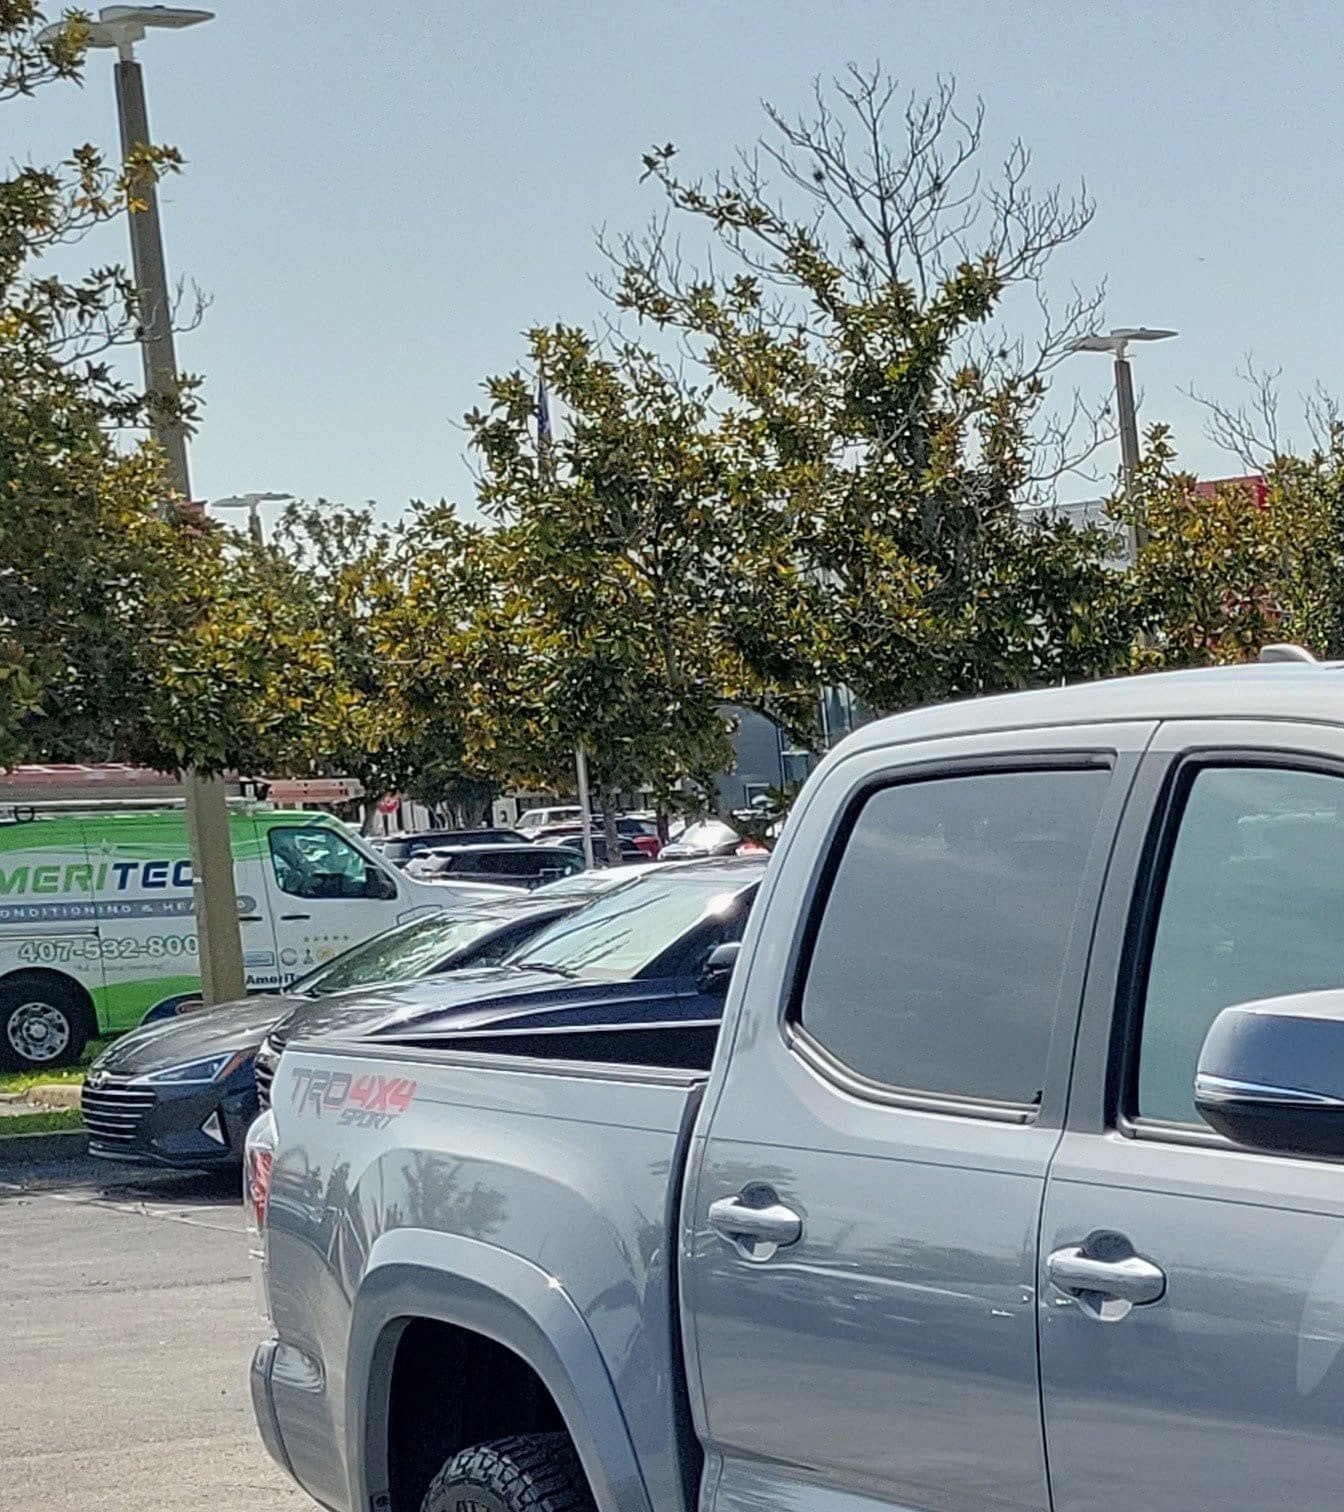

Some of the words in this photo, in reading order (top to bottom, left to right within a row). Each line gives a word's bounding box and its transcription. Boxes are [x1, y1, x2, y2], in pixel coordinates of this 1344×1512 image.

[0, 860, 194, 895] MERITEC
[0, 904, 131, 919] ONDITIONING
[18, 934, 199, 963] 407-532-800
[246, 973, 299, 985] AmeriT
[292, 1067, 352, 1119] TRD
